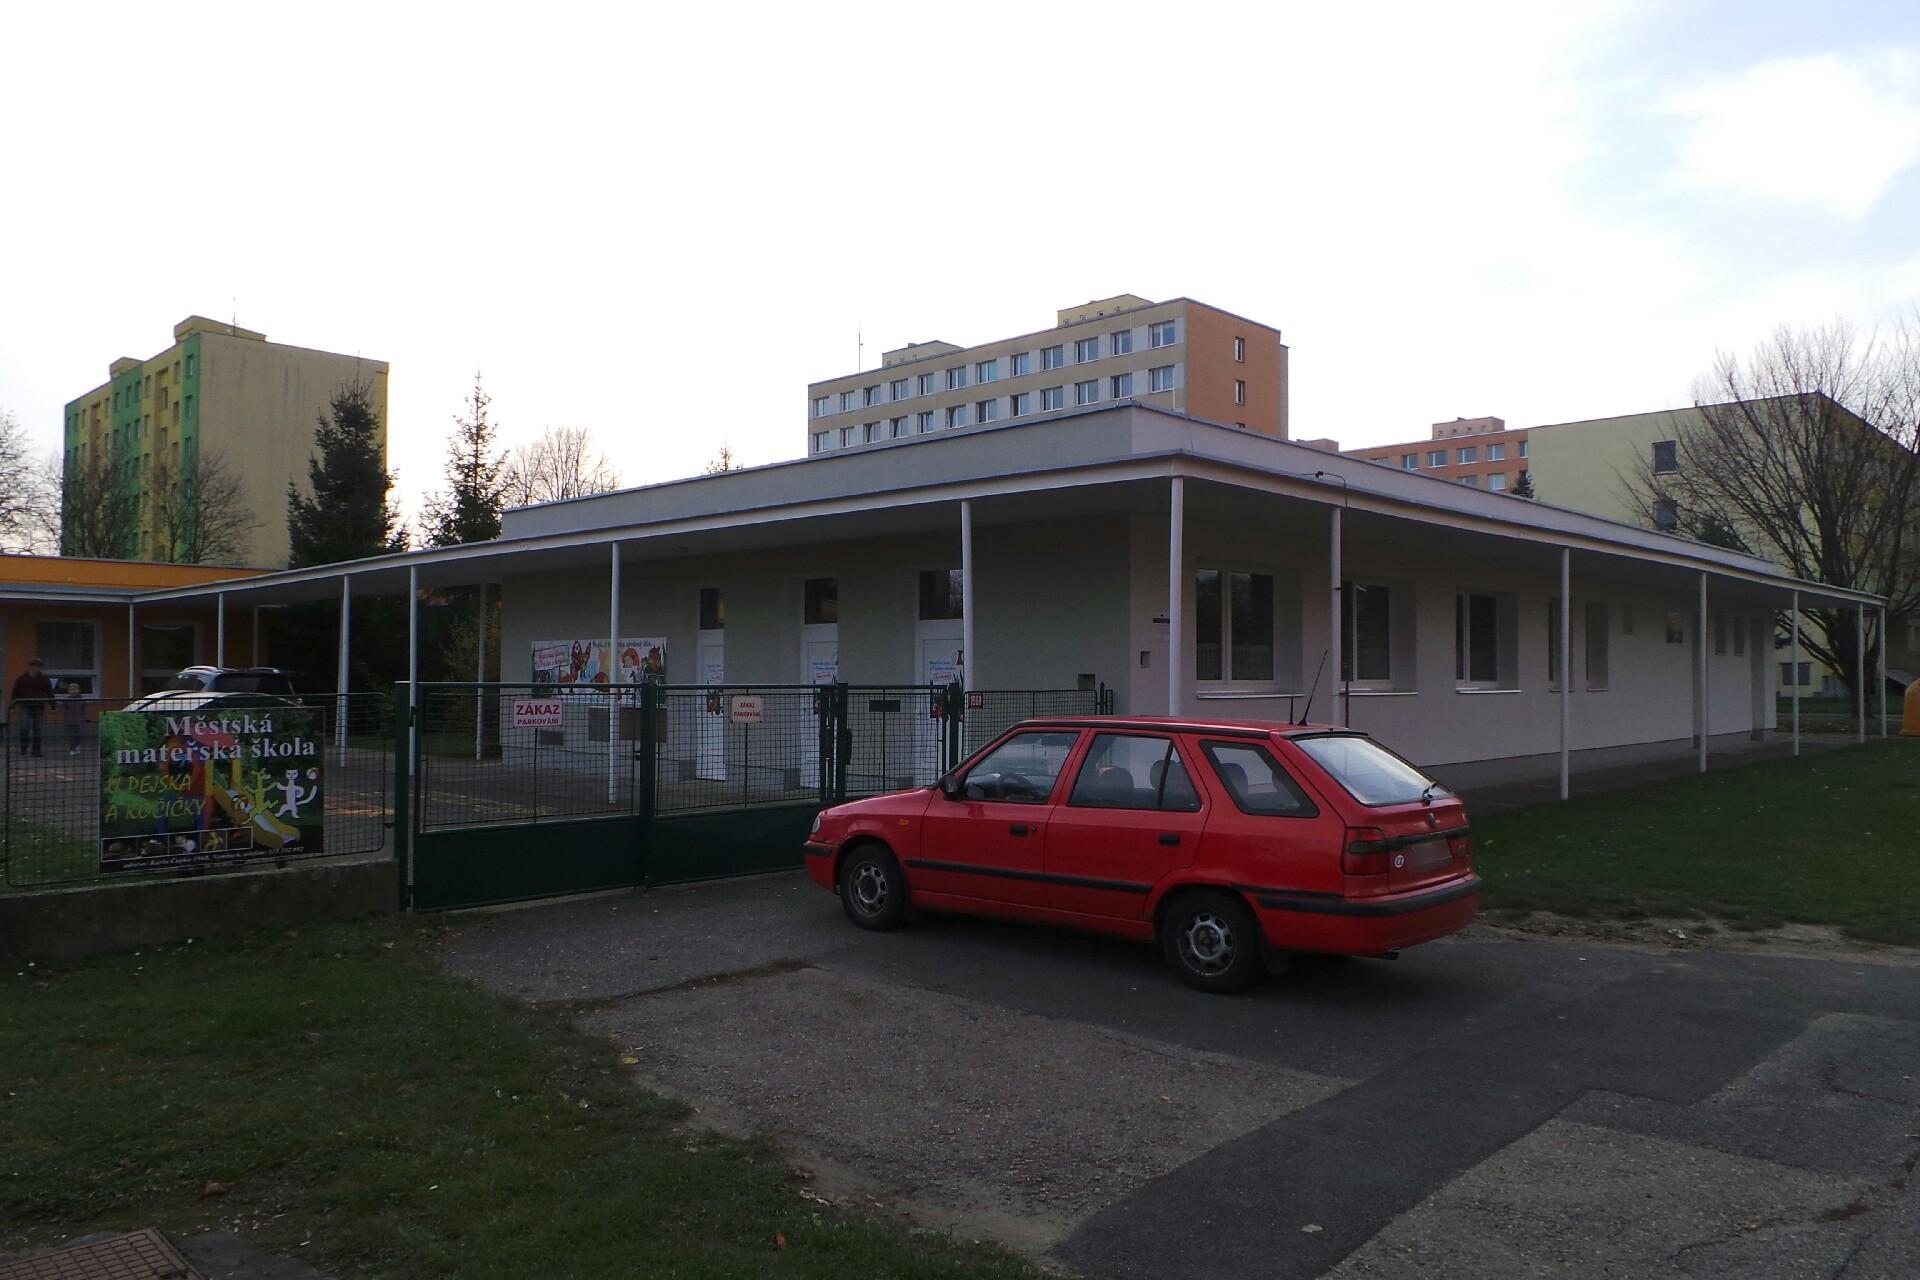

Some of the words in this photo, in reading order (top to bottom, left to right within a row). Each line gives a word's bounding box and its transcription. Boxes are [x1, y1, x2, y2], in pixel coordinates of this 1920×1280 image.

[516, 702, 561, 716] ZÁKAZ
[165, 714, 273, 736] Městská
[117, 739, 242, 764] mateřská
[251, 738, 315, 758] škola
[125, 798, 206, 820] KOČIČKY
